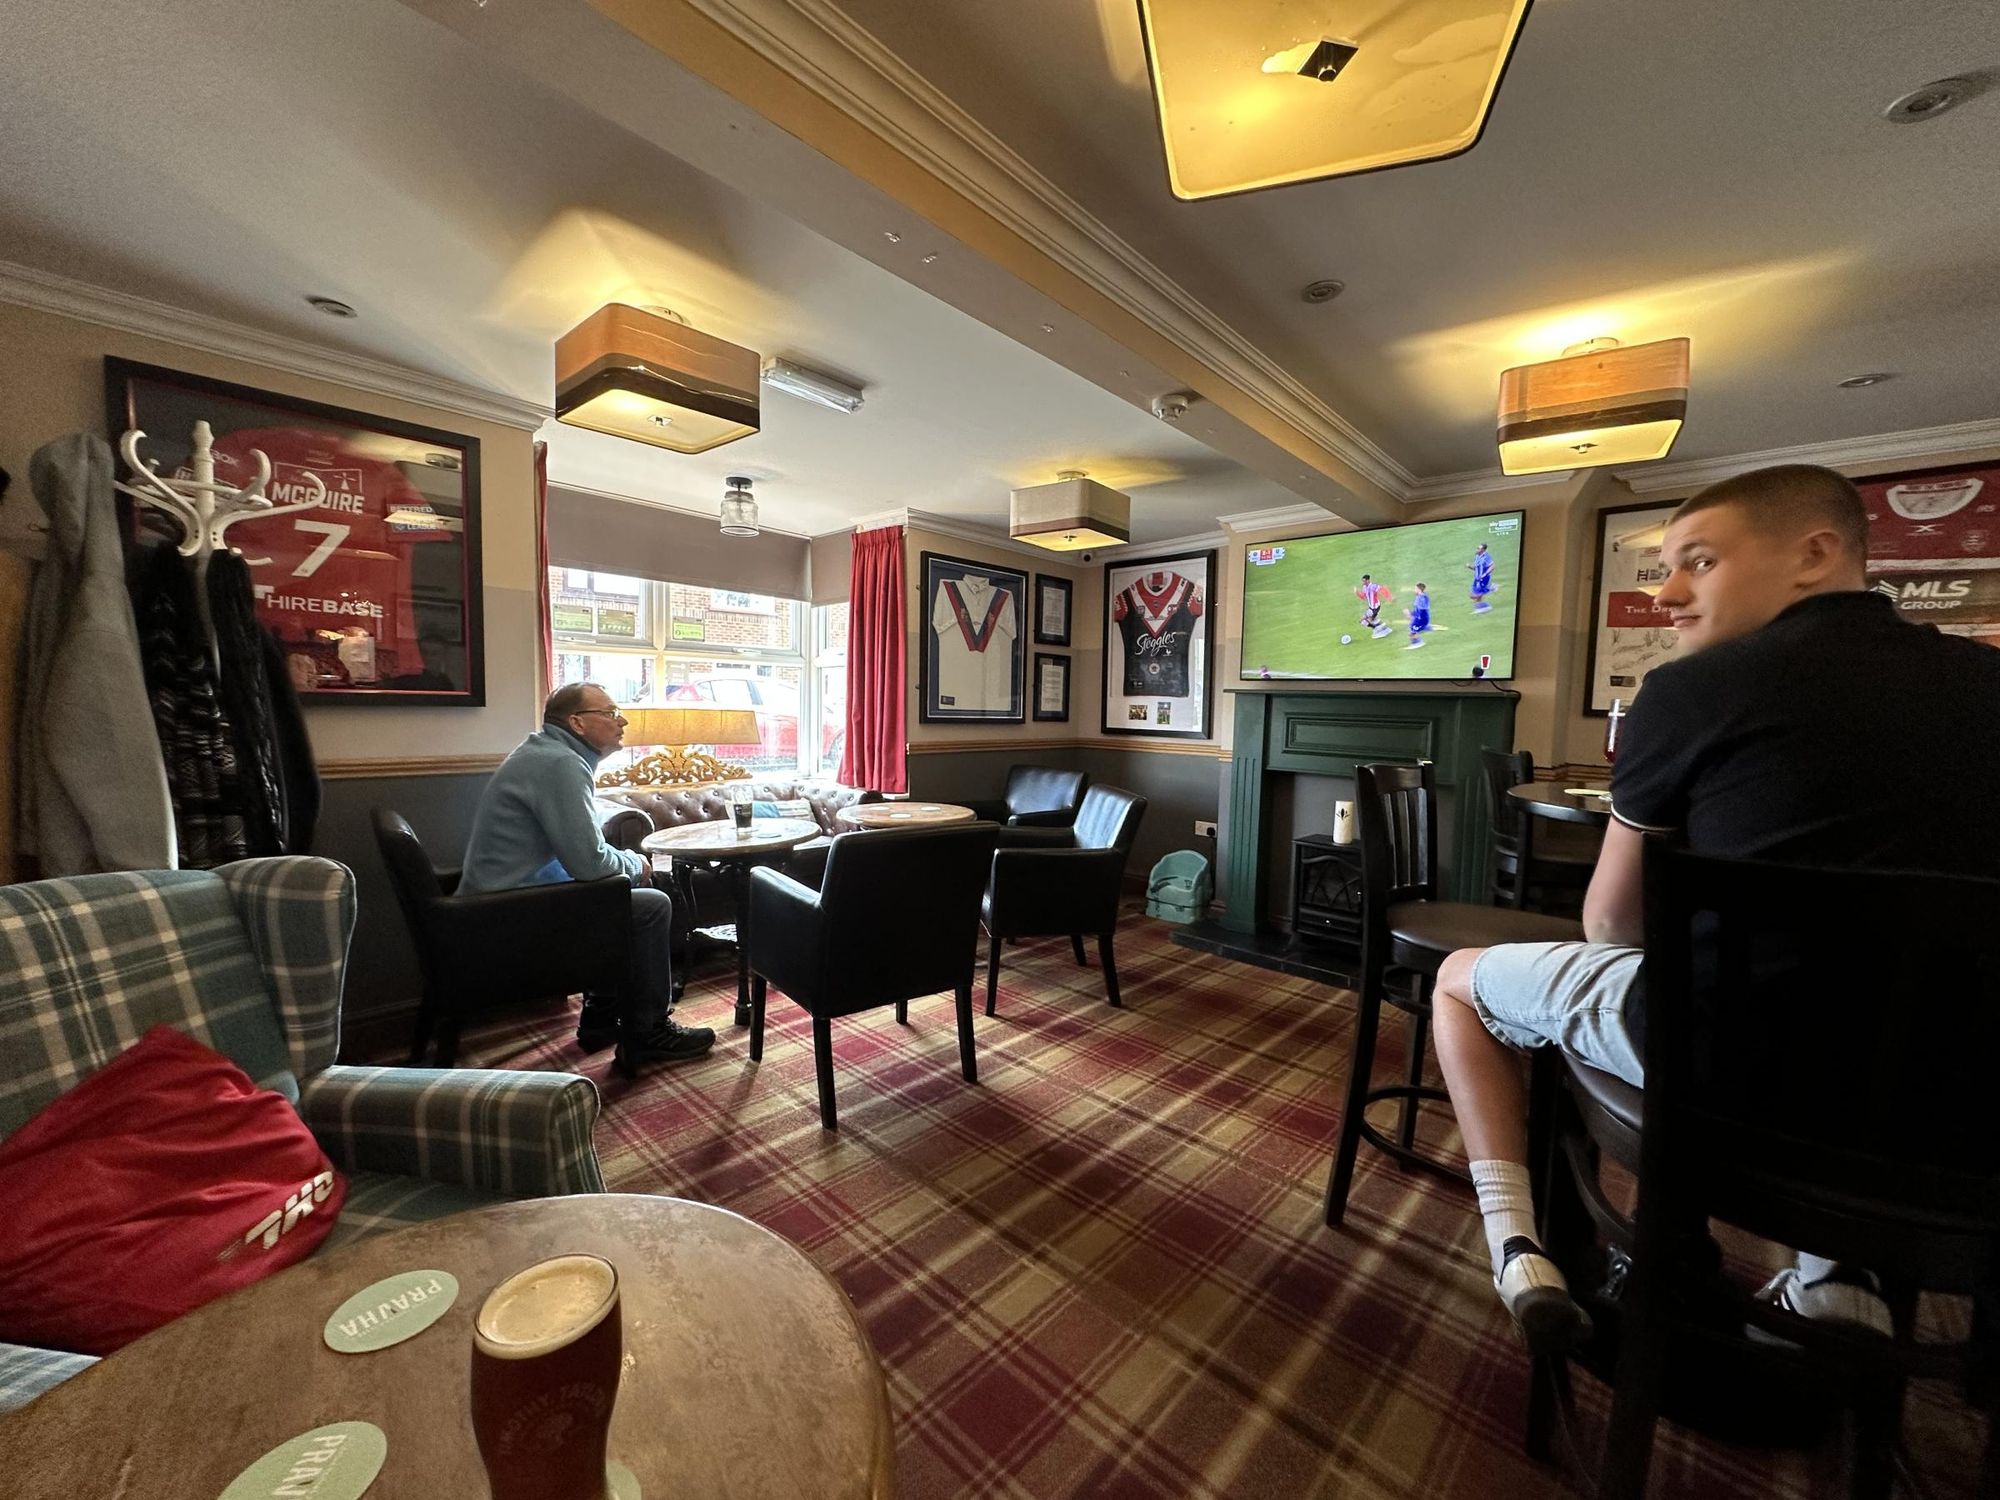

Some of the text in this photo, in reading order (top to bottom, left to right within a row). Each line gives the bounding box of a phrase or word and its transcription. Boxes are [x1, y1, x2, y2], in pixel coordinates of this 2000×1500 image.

[272, 481, 365, 515] MCGUIRE
[291, 519, 351, 578] 7
[1902, 580, 1972, 598] MLS
[267, 594, 384, 618] HIREBASE
[1900, 600, 1962, 610] GROUP
[1135, 631, 1178, 657] Steggles
[339, 1279, 443, 1337] PRAVHA
[271, 1434, 348, 1500] PRAV
